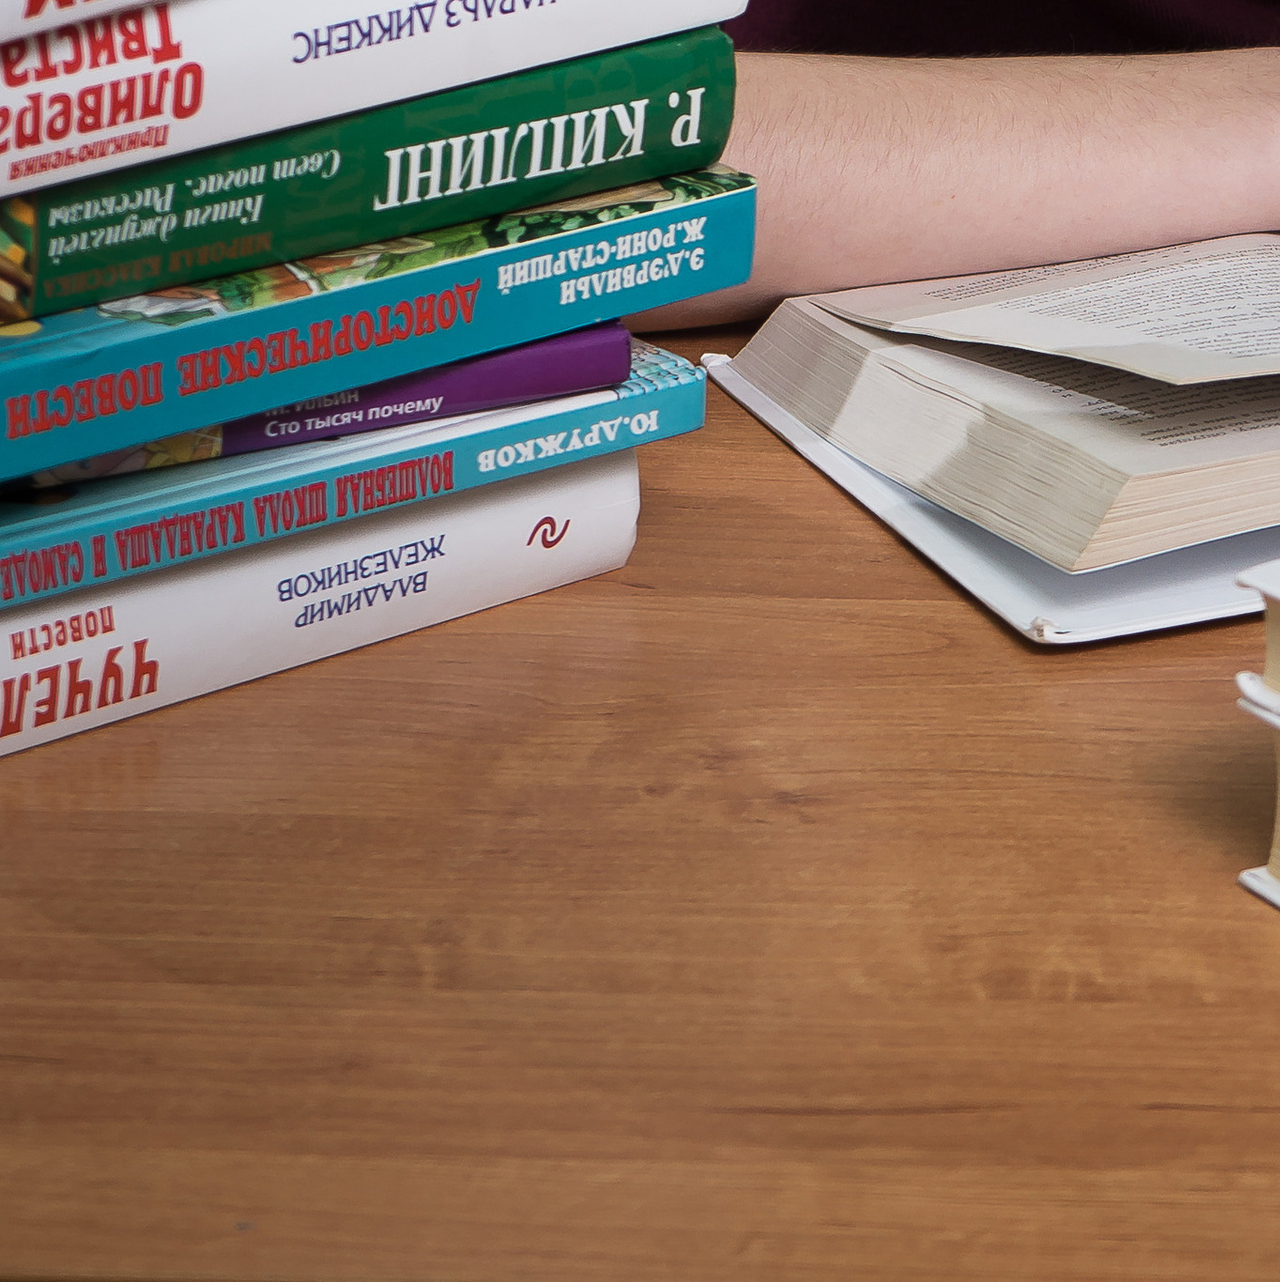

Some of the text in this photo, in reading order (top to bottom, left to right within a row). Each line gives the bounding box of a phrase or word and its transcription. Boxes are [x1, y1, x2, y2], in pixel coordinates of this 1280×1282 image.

[8, 124, 170, 181] Приключения
[373, 87, 707, 211] Р. КИПЛИНГ
[48, 148, 342, 229] Свет погас. Рассказы
[47, 193, 265, 267] Книги джунглей
[168, 230, 275, 271] МИРОВАЯ
[497, 215, 707, 294] Ж.РОНИ-СТАРШИЙ
[5, 277, 481, 440] ДОИСТОРИЧЕСКИЕ ПОВЕСТИ
[265, 419, 301, 438] Сто
[304, 410, 364, 431] тысяч
[367, 394, 444, 423] почему
[252, 480, 328, 538] ШКОЛА
[335, 450, 455, 518] ВОЛШЕБНАЯ
[92, 534, 107, 578] И
[115, 500, 246, 572] КАРАНДАША
[277, 534, 447, 603] ЖЕЛЕЗНИКОВ
[294, 570, 429, 630] ВЛАДИМИР
